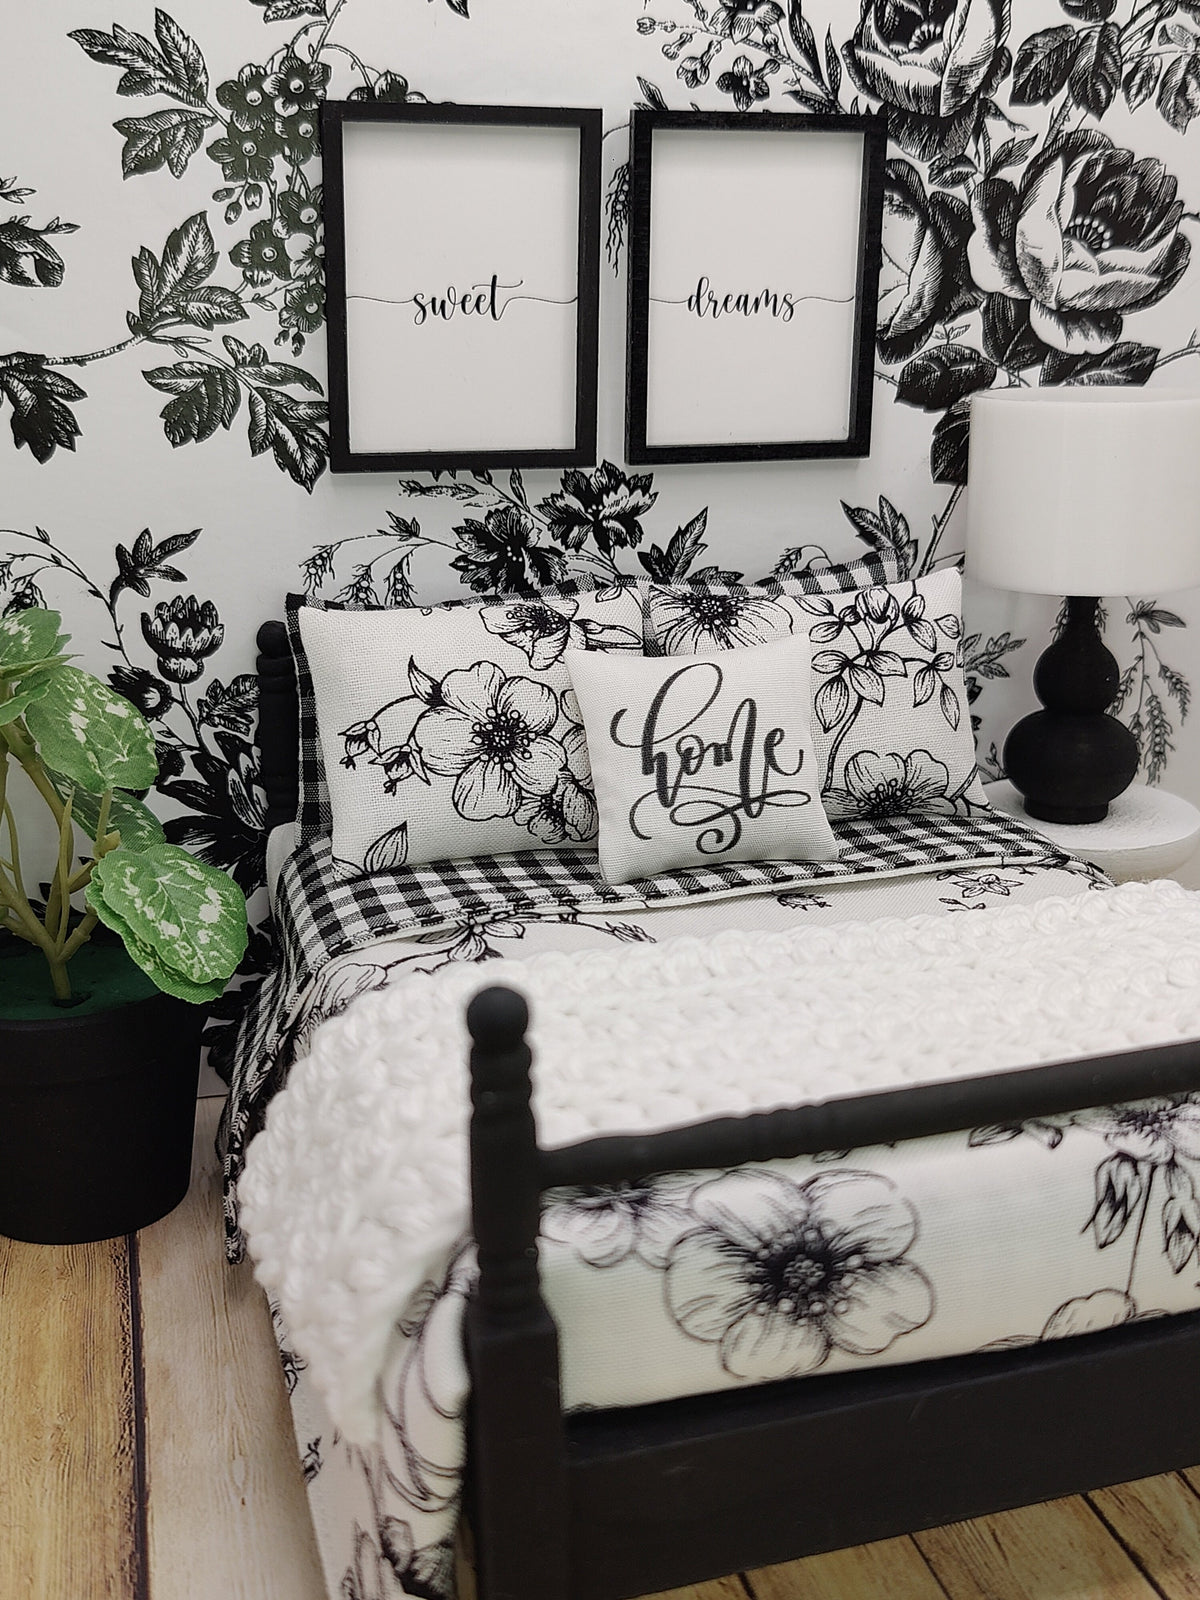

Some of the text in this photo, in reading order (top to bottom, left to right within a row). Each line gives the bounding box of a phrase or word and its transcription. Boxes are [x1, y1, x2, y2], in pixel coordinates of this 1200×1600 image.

[412, 274, 523, 325] sweet
[686, 276, 795, 323] dreams
[610, 662, 811, 854] home
